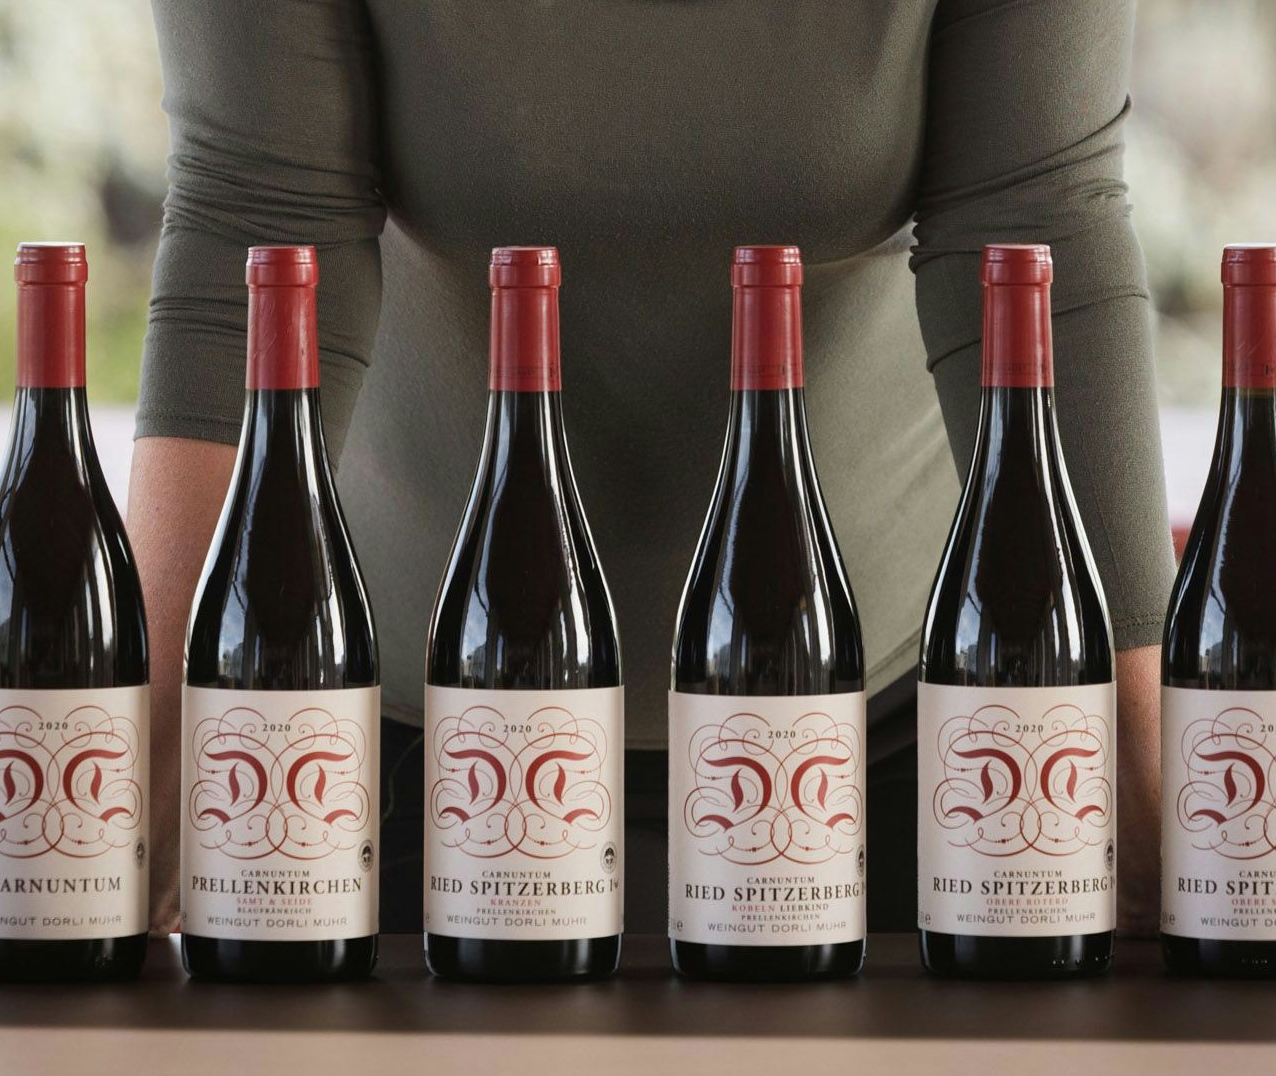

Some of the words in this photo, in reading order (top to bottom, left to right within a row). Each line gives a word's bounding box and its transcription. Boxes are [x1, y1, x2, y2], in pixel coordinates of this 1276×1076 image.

[39, 722, 68, 730] 2020
[263, 724, 290, 732] 2020
[503, 725, 531, 733] 2020
[1016, 725, 1043, 733] 2020
[768, 731, 795, 739] 2020
[241, 869, 310, 878] CARNUNTUM
[482, 870, 550, 879] CARNUNTUM
[994, 870, 1062, 878] CARNUNTUM
[747, 876, 815, 885] CARNUNTUM
[192, 876, 362, 895] PRELLENKIRCHEN
[431, 876, 462, 894] RIED
[470, 878, 605, 896] SPITZERBERG
[933, 876, 972, 894] RIED
[981, 876, 1108, 895] SPITZERBERG
[1178, 877, 1217, 894] RIED
[685, 884, 725, 901] RIED
[734, 882, 860, 902] SPITZERBERG
[281, 897, 312, 906] SEIDE
[490, 898, 541, 907] KRANZEN
[780, 902, 829, 911] LIEBKIND
[42, 916, 83, 927] DORLI
[89, 915, 122, 925] MUHR
[207, 916, 260, 928] WEINGUT
[266, 918, 308, 928] DORLI
[314, 917, 347, 927] MUHR
[447, 915, 497, 926] WEINGUT
[505, 917, 546, 927] DORLI
[552, 916, 586, 926] MUHR
[957, 913, 1015, 924] WEINGUT
[1021, 914, 1060, 925] DORLI
[1066, 913, 1096, 922] MUHR
[1200, 916, 1259, 927] WEINGUT
[708, 922, 765, 933] WEINGUT
[772, 923, 811, 934] DORLI
[816, 921, 846, 931] MUHR
